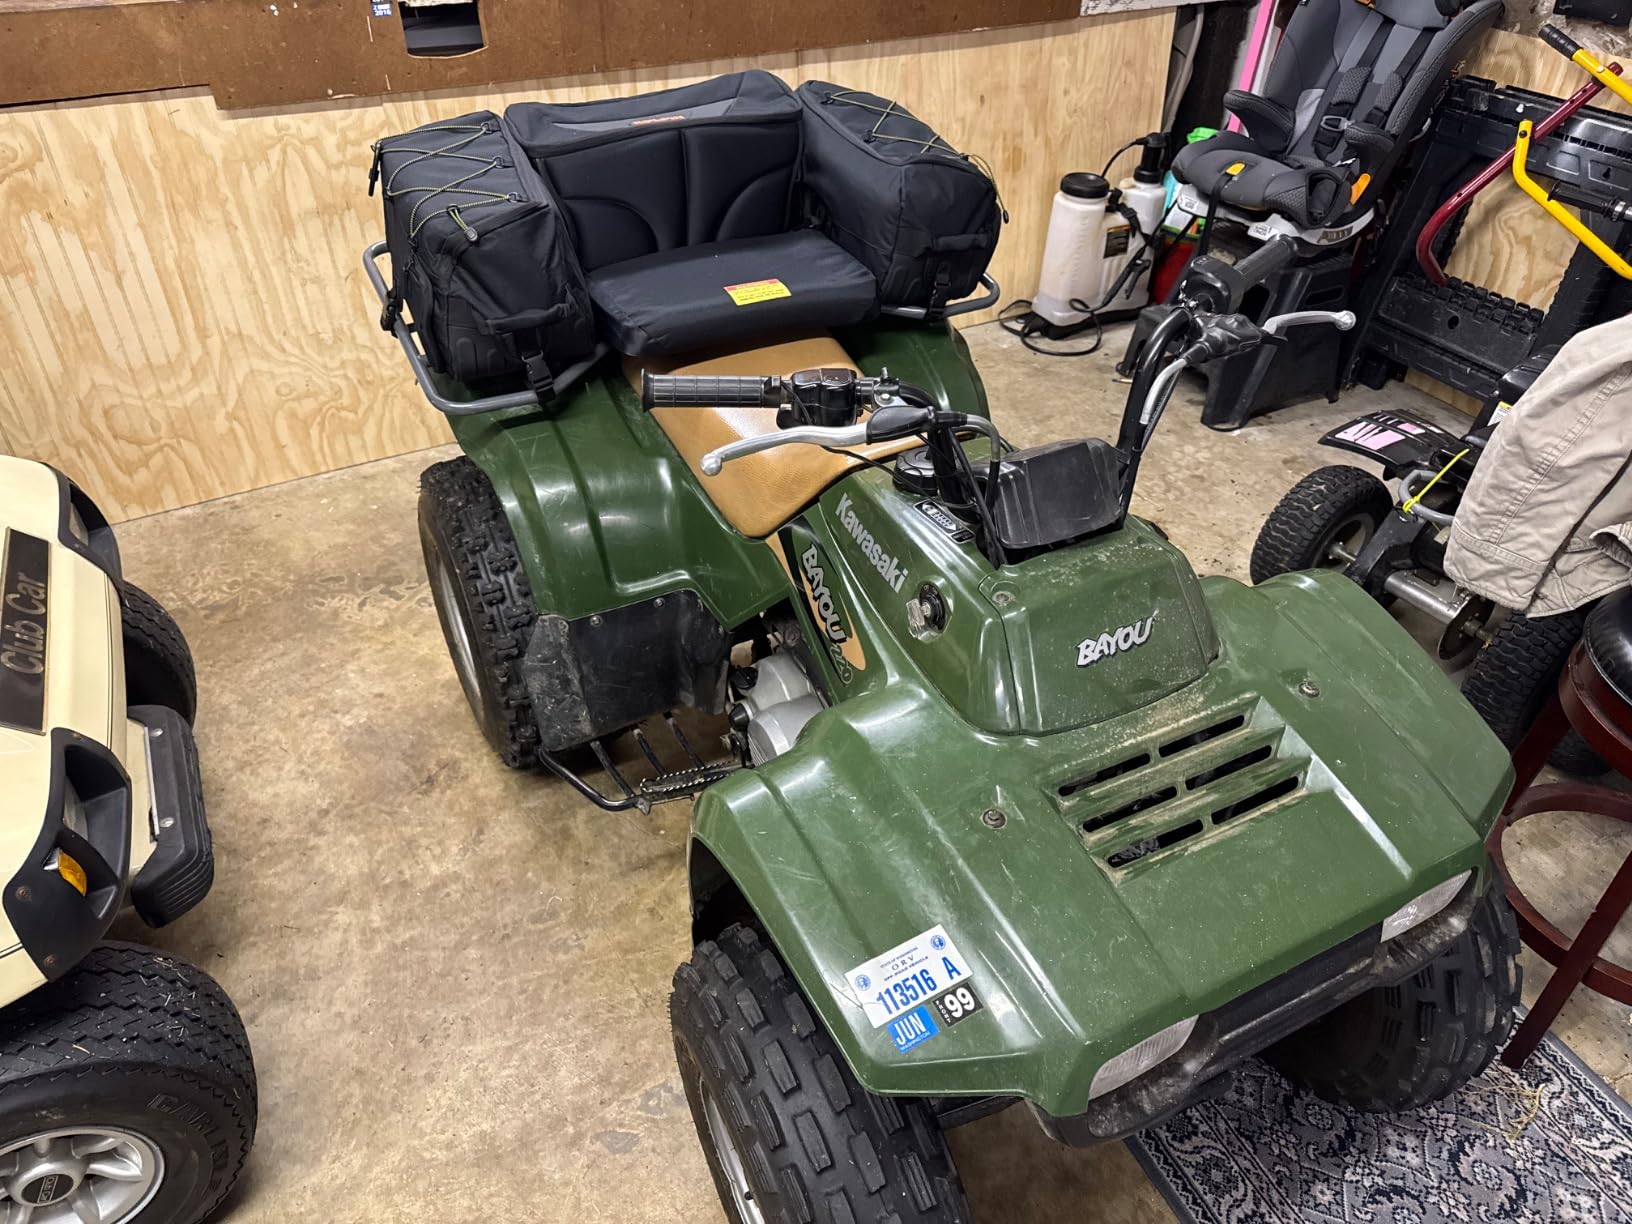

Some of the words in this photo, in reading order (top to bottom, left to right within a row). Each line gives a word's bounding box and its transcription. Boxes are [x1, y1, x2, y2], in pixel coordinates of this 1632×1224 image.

[835, 493, 908, 593] Kawasaki
[6, 571, 46, 615] Car
[802, 544, 848, 645] BAYOU
[1, 620, 44, 674] Club
[1077, 610, 1157, 667] BAYOU
[876, 968, 938, 1015] 113516
[941, 956, 962, 980] A
[943, 987, 975, 1018] 99
[894, 1012, 927, 1045] JUN
